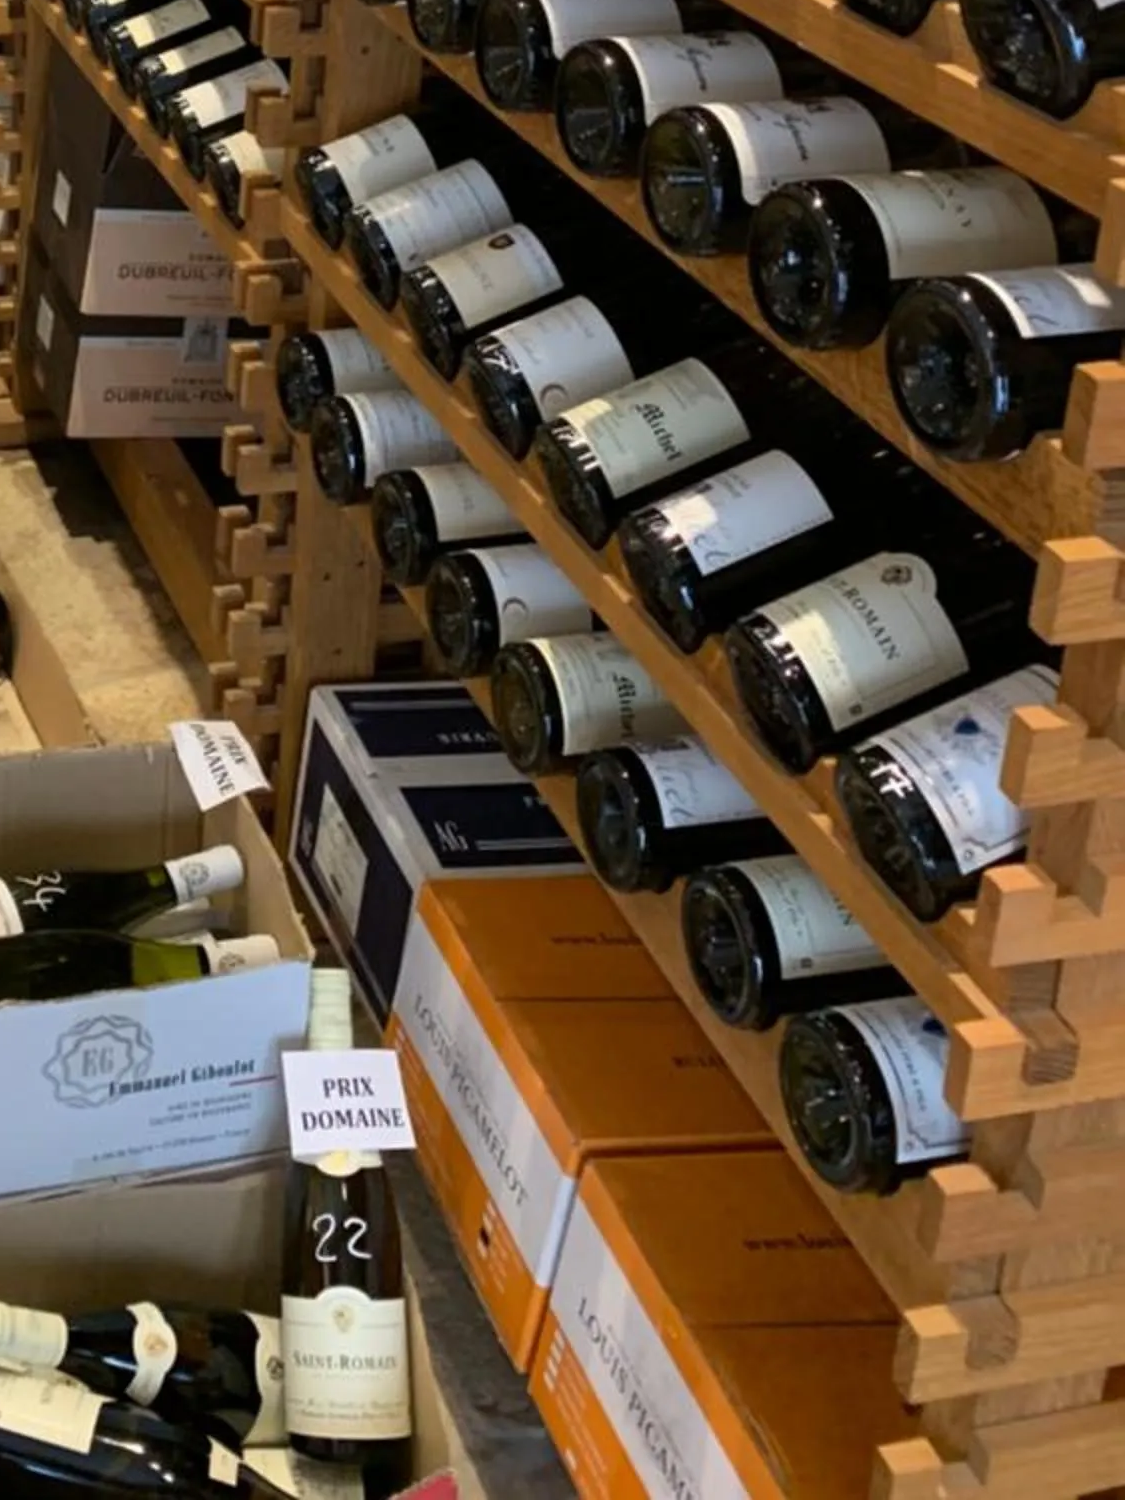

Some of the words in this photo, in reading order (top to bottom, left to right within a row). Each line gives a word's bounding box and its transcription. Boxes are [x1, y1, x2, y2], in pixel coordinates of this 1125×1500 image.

[635, 403, 683, 462] Michel
[189, 723, 235, 797] DOMAINE
[322, 1076, 375, 1099] PRIX
[301, 1107, 406, 1132] DOMAINE
[312, 1213, 372, 1263] 22
[292, 1349, 397, 1371] SAINT-ROMAIN
[578, 1296, 629, 1394] LOUIS
